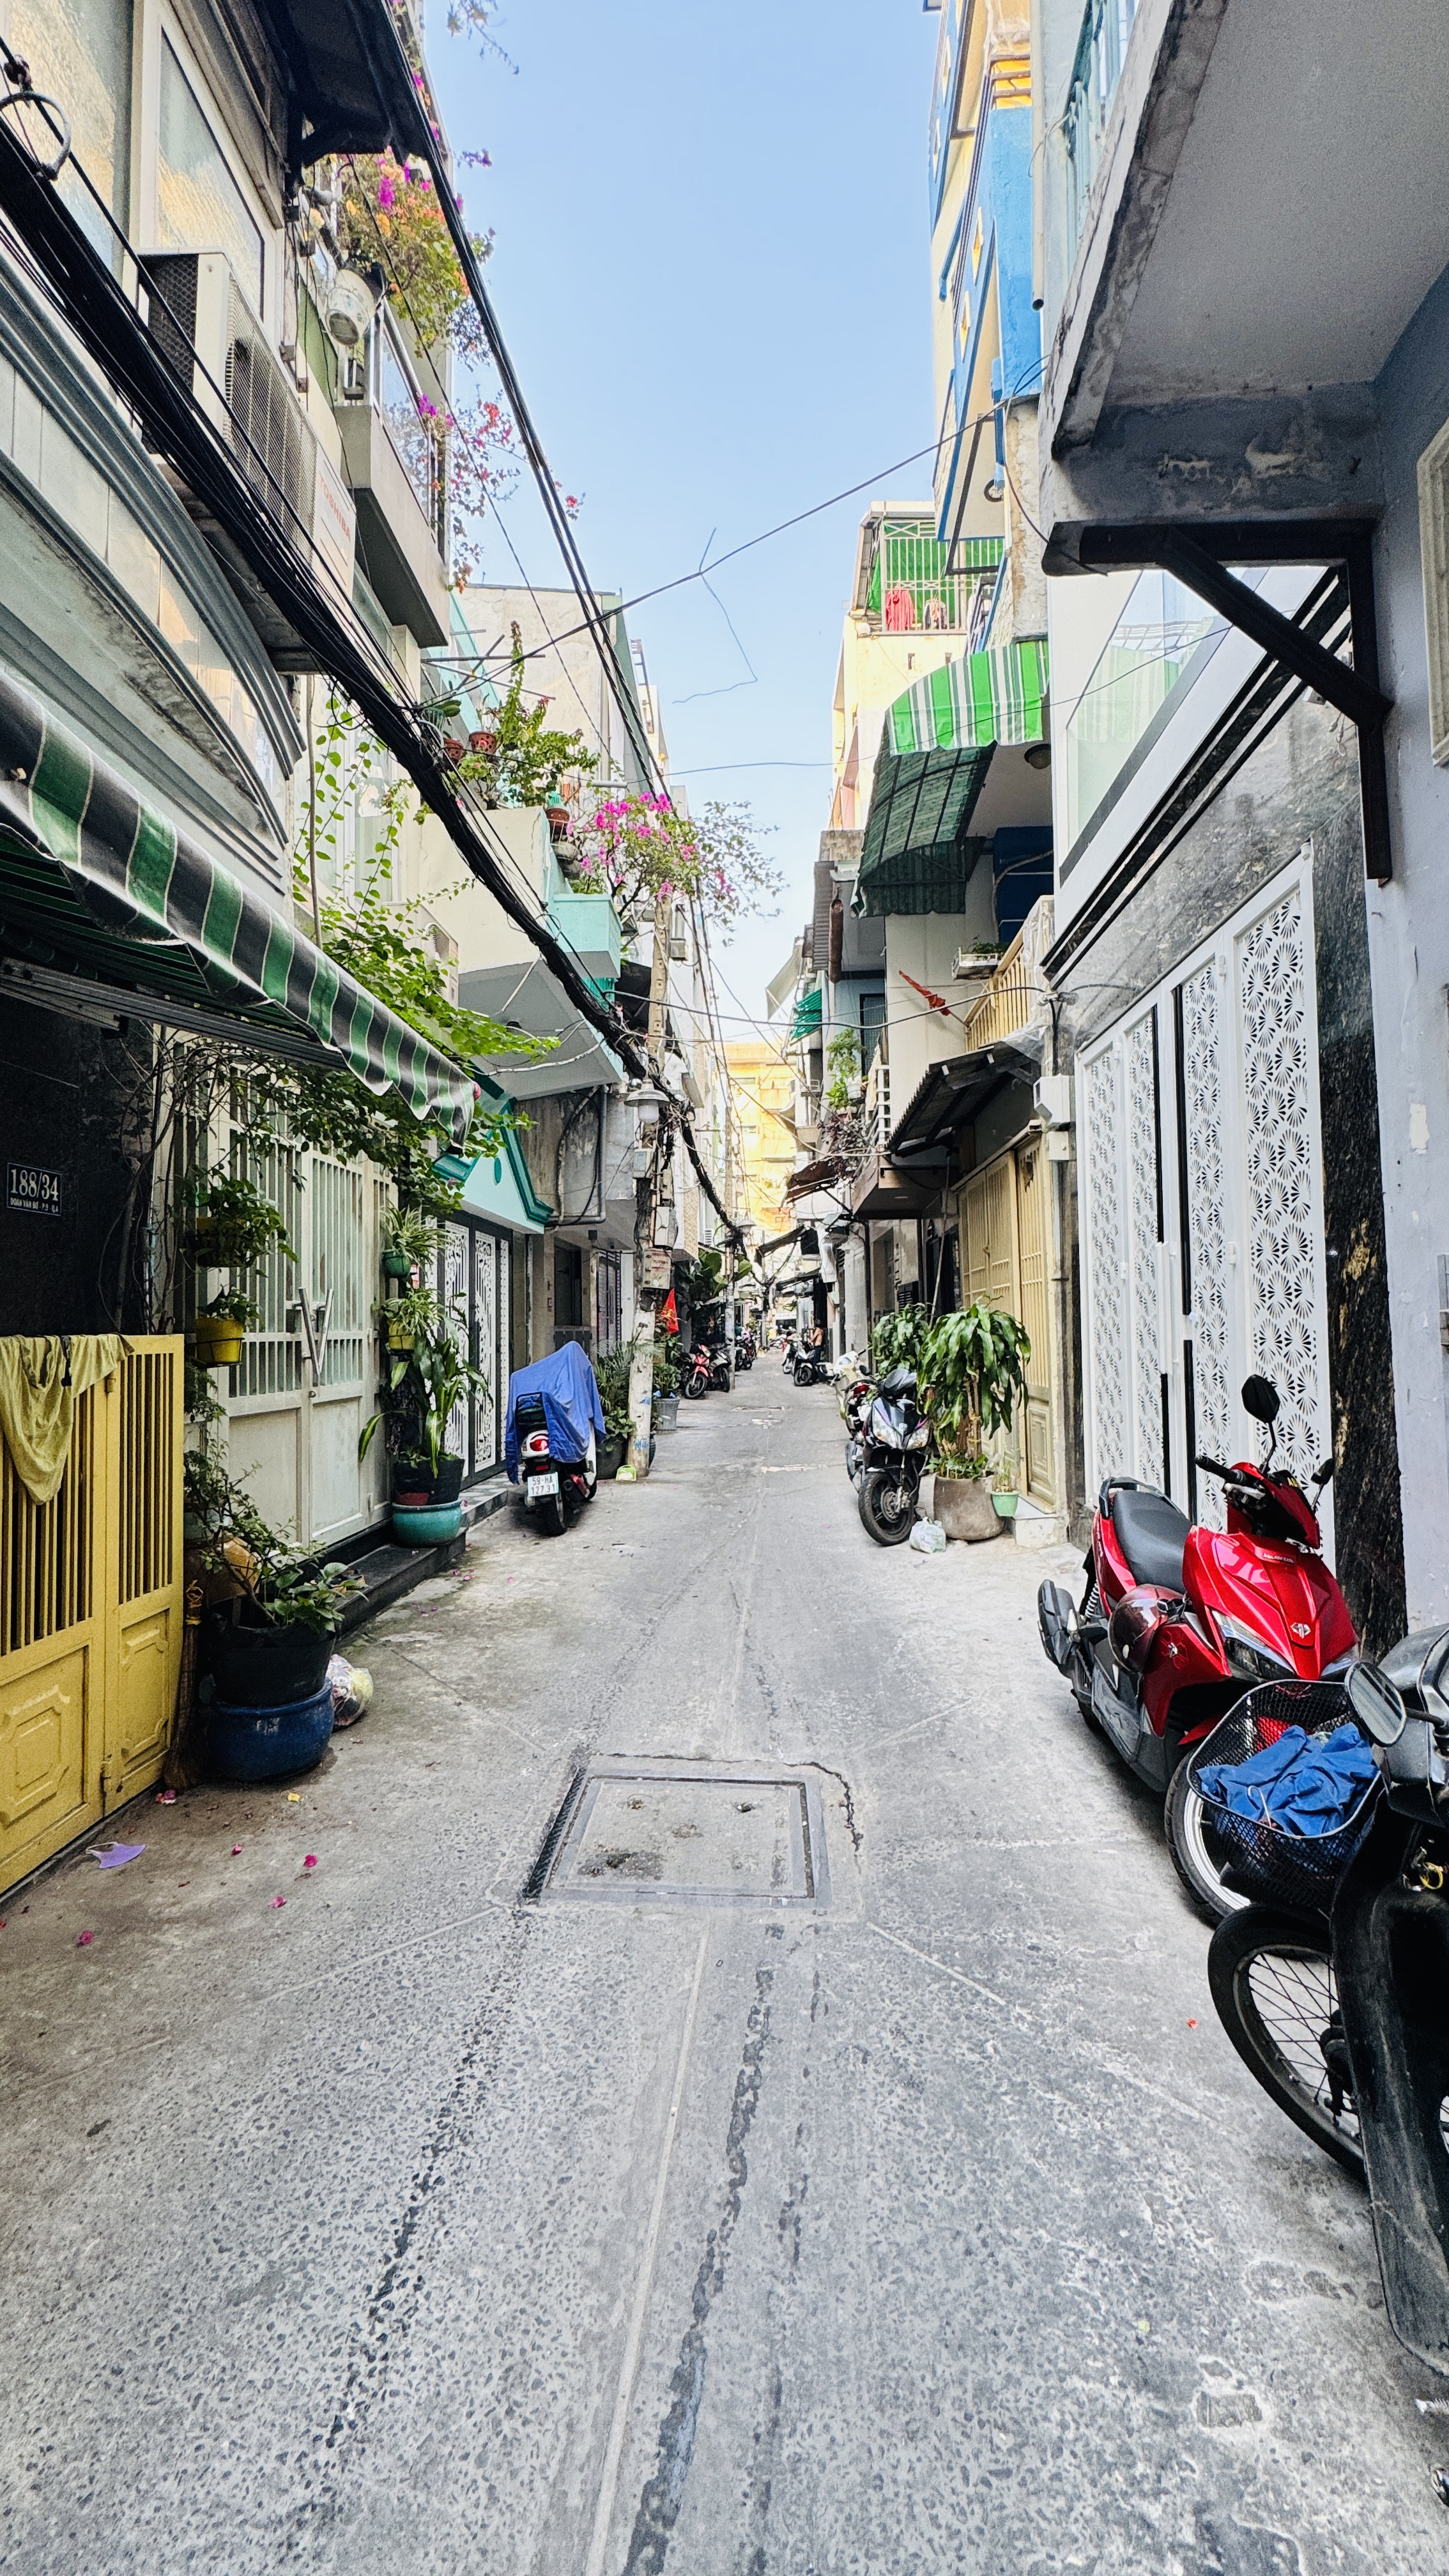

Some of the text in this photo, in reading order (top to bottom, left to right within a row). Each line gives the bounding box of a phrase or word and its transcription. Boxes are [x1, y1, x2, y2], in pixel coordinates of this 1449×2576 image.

[319, 471, 351, 542] TOSHIBA
[11, 1169, 58, 1200] 188/34
[1263, 1552, 1294, 1564] HONDA
